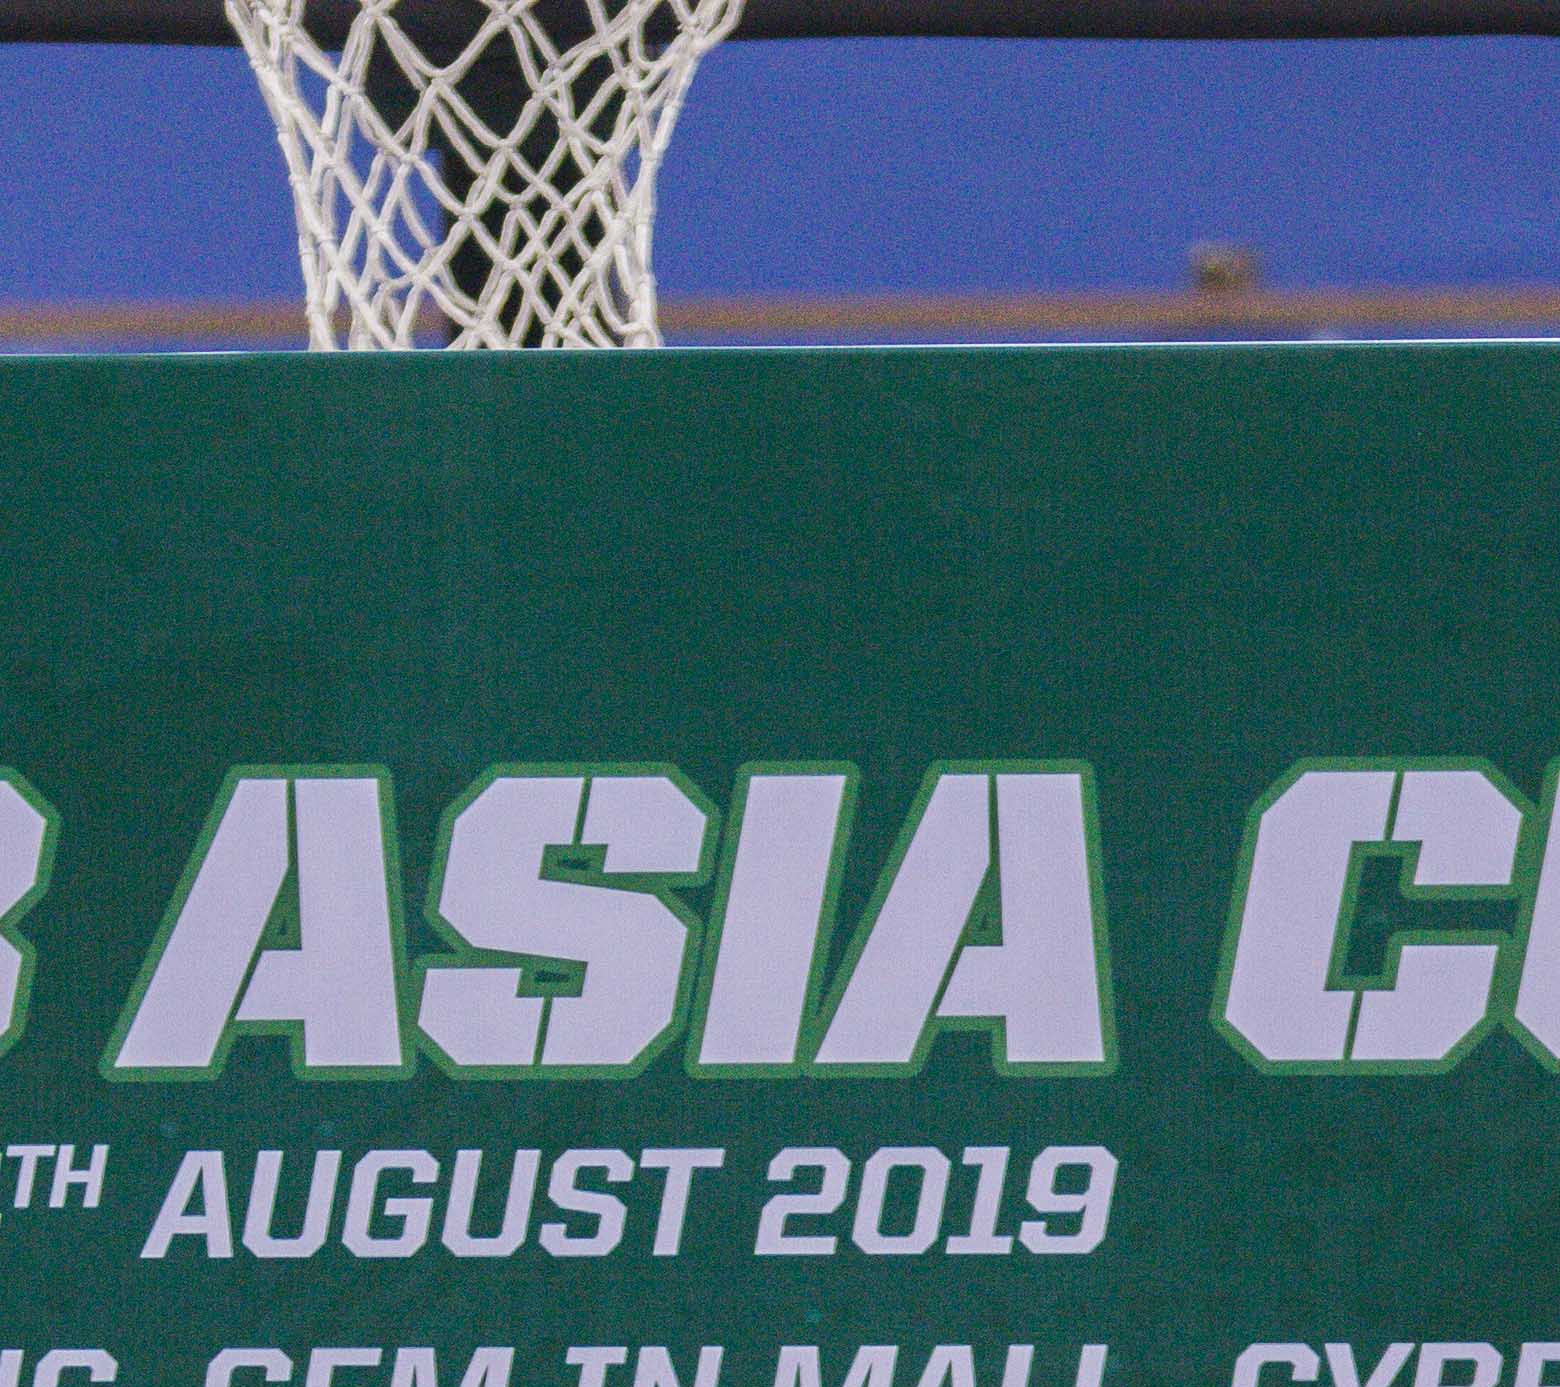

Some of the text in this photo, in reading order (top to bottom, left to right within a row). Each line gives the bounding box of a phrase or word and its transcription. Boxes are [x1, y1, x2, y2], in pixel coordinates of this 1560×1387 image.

[112, 769, 1107, 1073] ASIA
[140, 1148, 725, 1258] AUGUST
[754, 1146, 1119, 1255] 2019
